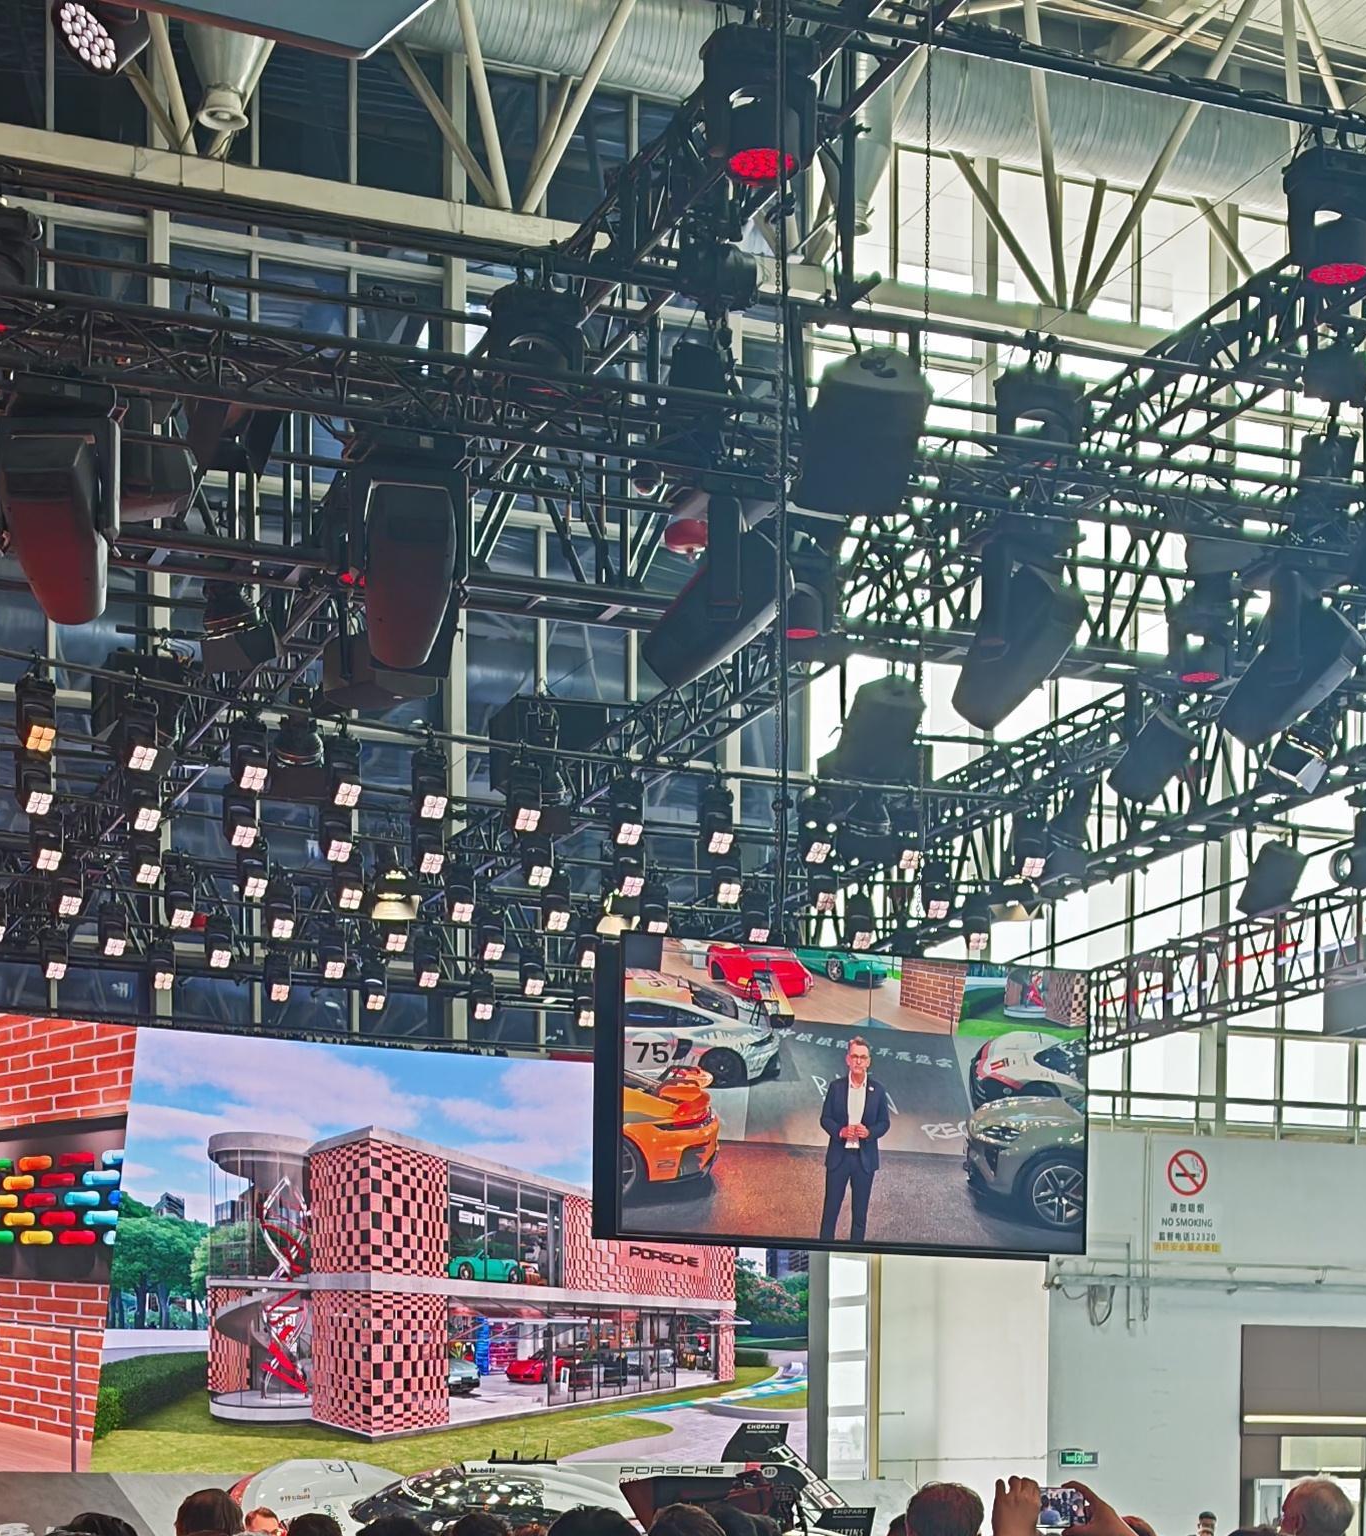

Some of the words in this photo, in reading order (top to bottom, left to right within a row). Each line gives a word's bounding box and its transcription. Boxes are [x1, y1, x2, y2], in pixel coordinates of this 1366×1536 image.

[632, 1041, 670, 1064] 75
[1161, 1217, 1174, 1227] NO
[1176, 1218, 1213, 1227] SMOKING
[629, 1245, 699, 1268] PORSCHE
[619, 1465, 725, 1475] PORSCHE
